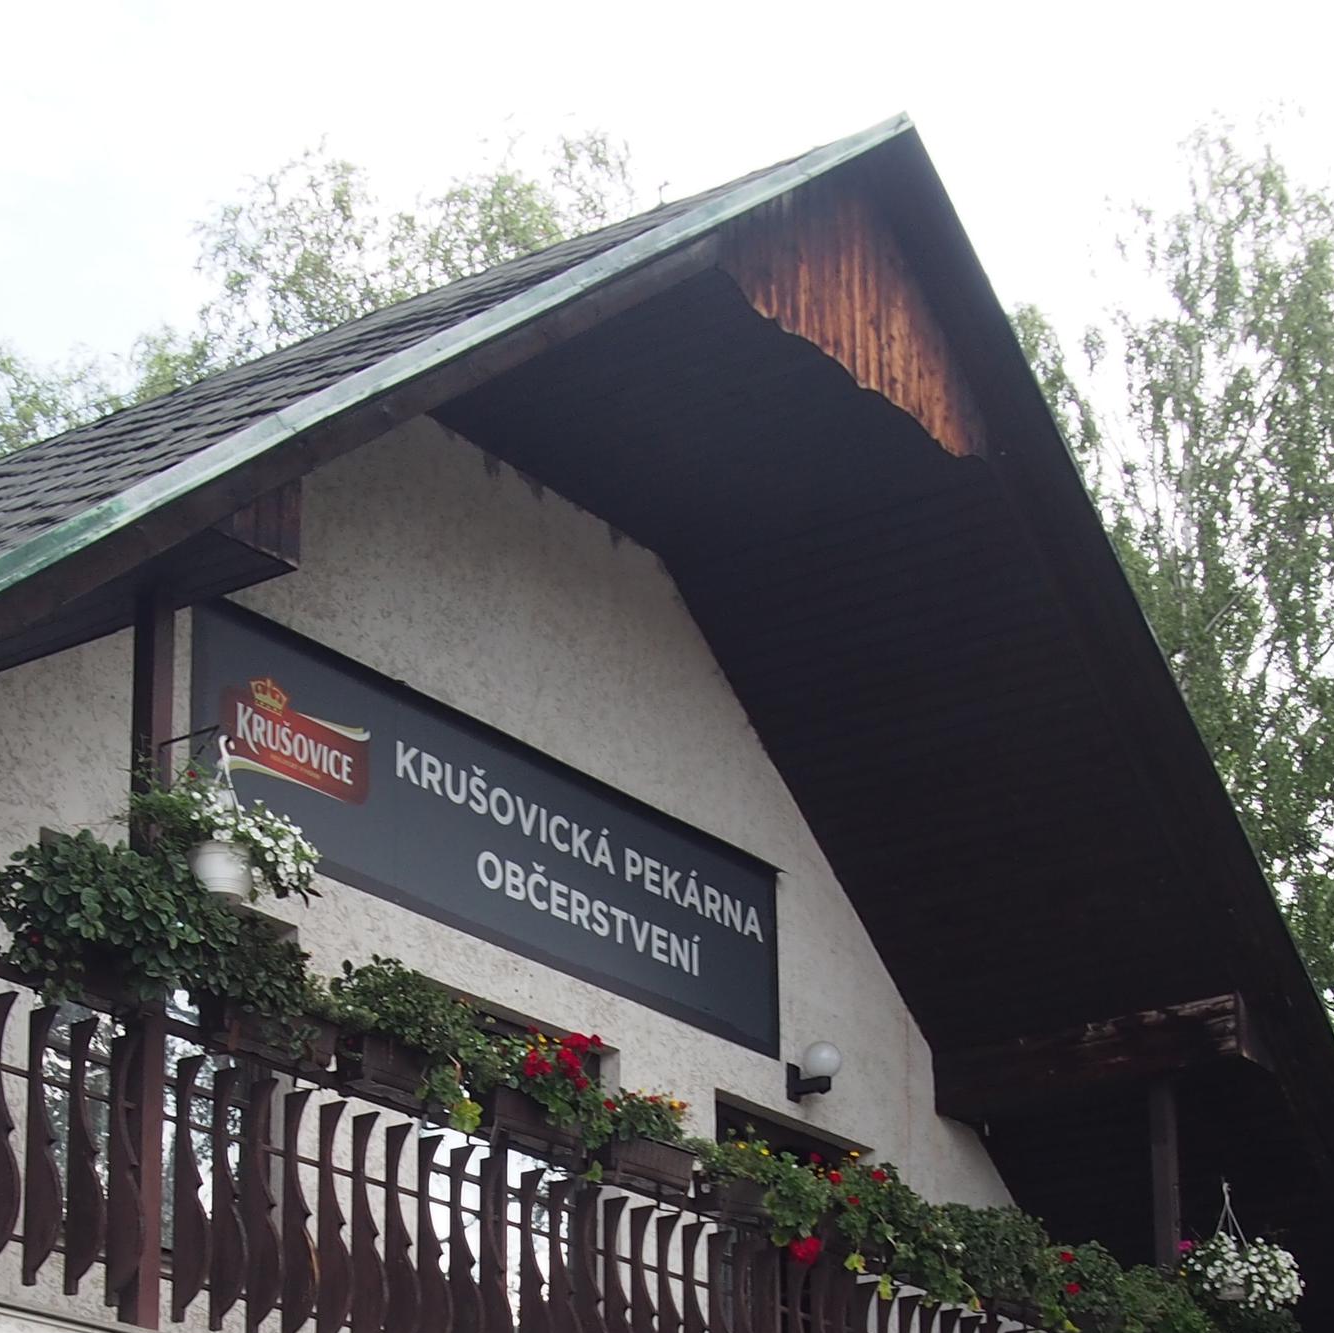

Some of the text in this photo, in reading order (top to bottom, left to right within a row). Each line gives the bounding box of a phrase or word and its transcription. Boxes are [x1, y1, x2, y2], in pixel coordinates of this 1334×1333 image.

[236, 702, 354, 785] KRUŠOVICE
[395, 740, 764, 943] KRUŠOVICKÁ PEKÁRNA
[476, 850, 700, 977] OBČERSTVENÍ
